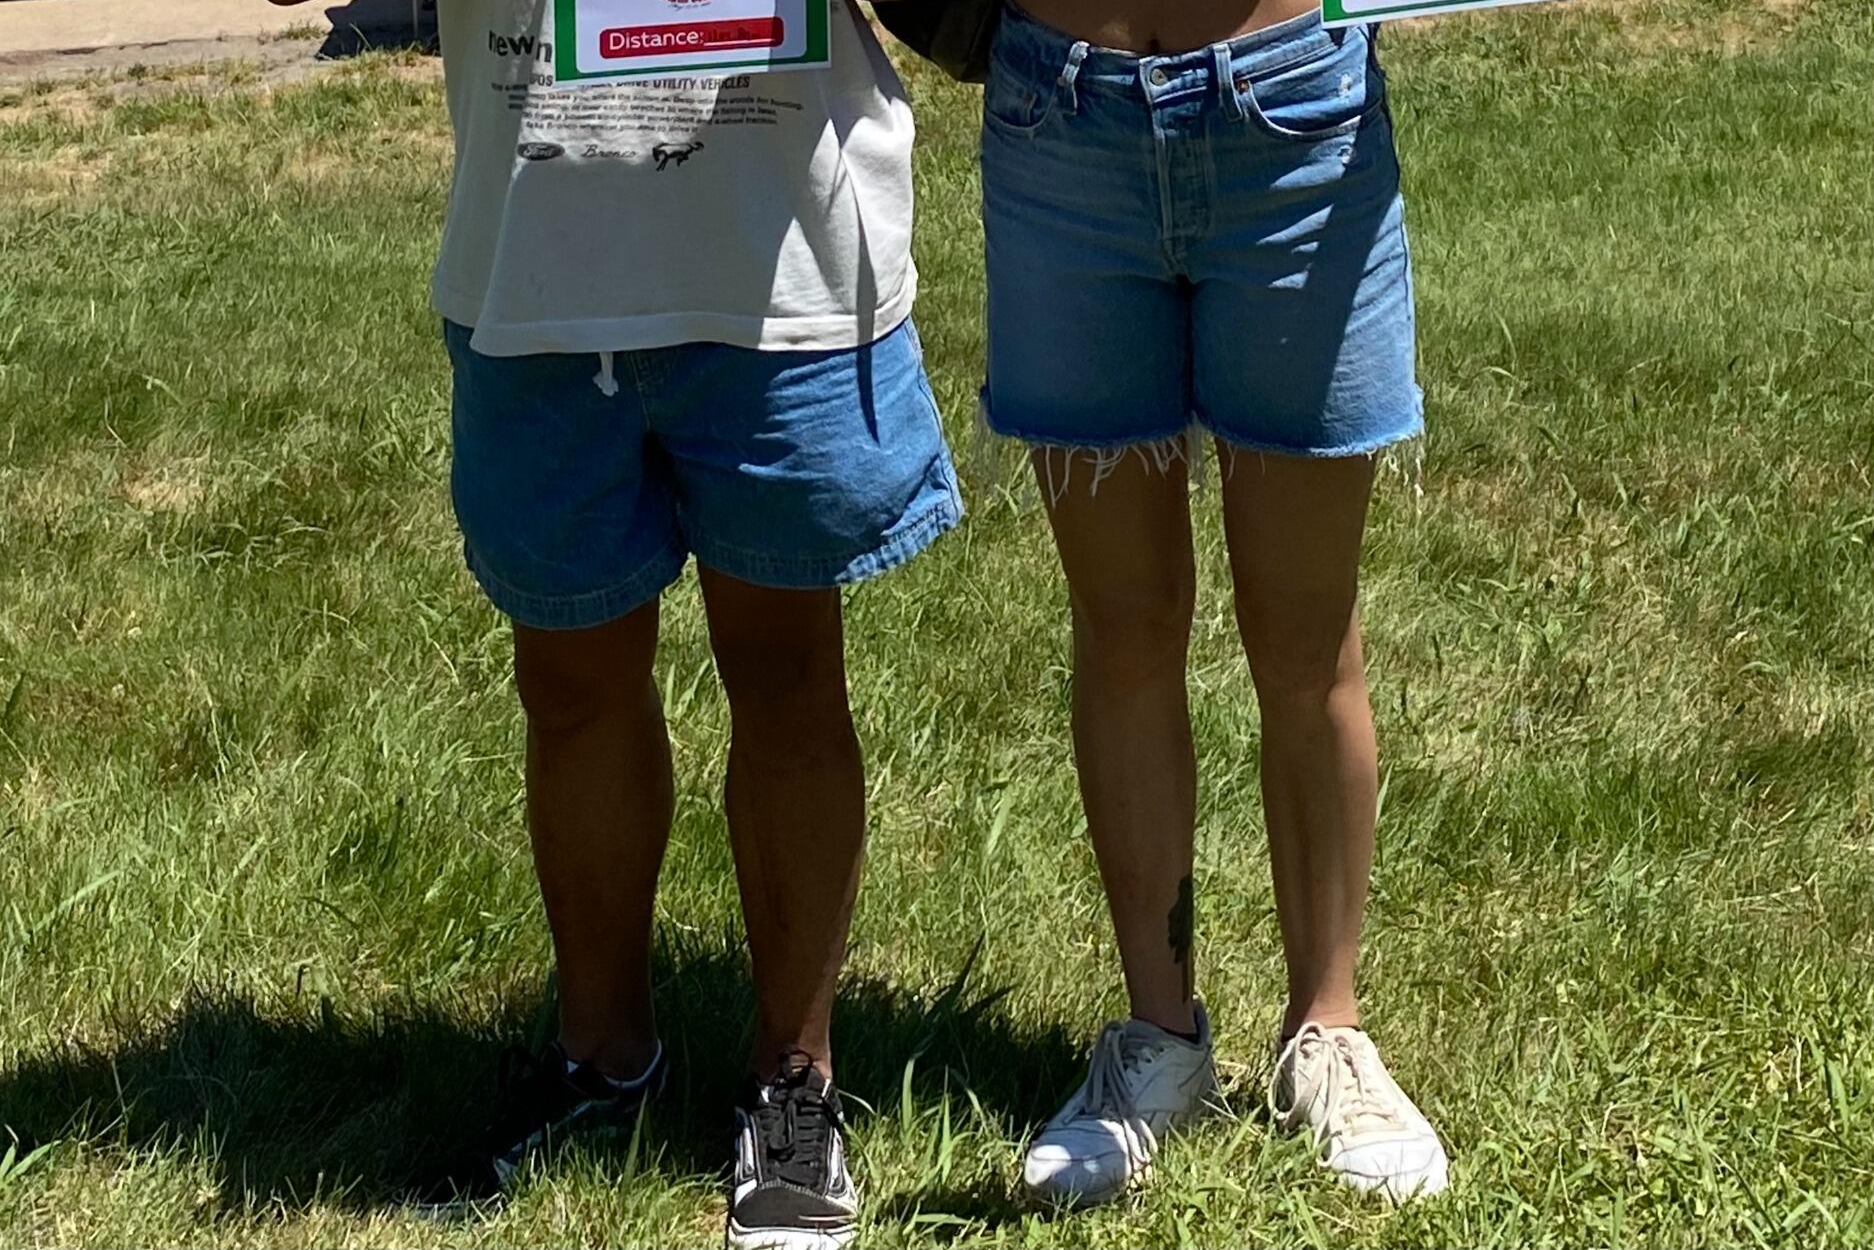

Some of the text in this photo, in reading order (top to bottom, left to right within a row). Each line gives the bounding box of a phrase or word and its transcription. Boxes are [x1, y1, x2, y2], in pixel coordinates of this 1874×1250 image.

[652, 76, 697, 91] UTILITY
[699, 74, 751, 91] VEHICLES
[581, 143, 637, 158] Bronco
